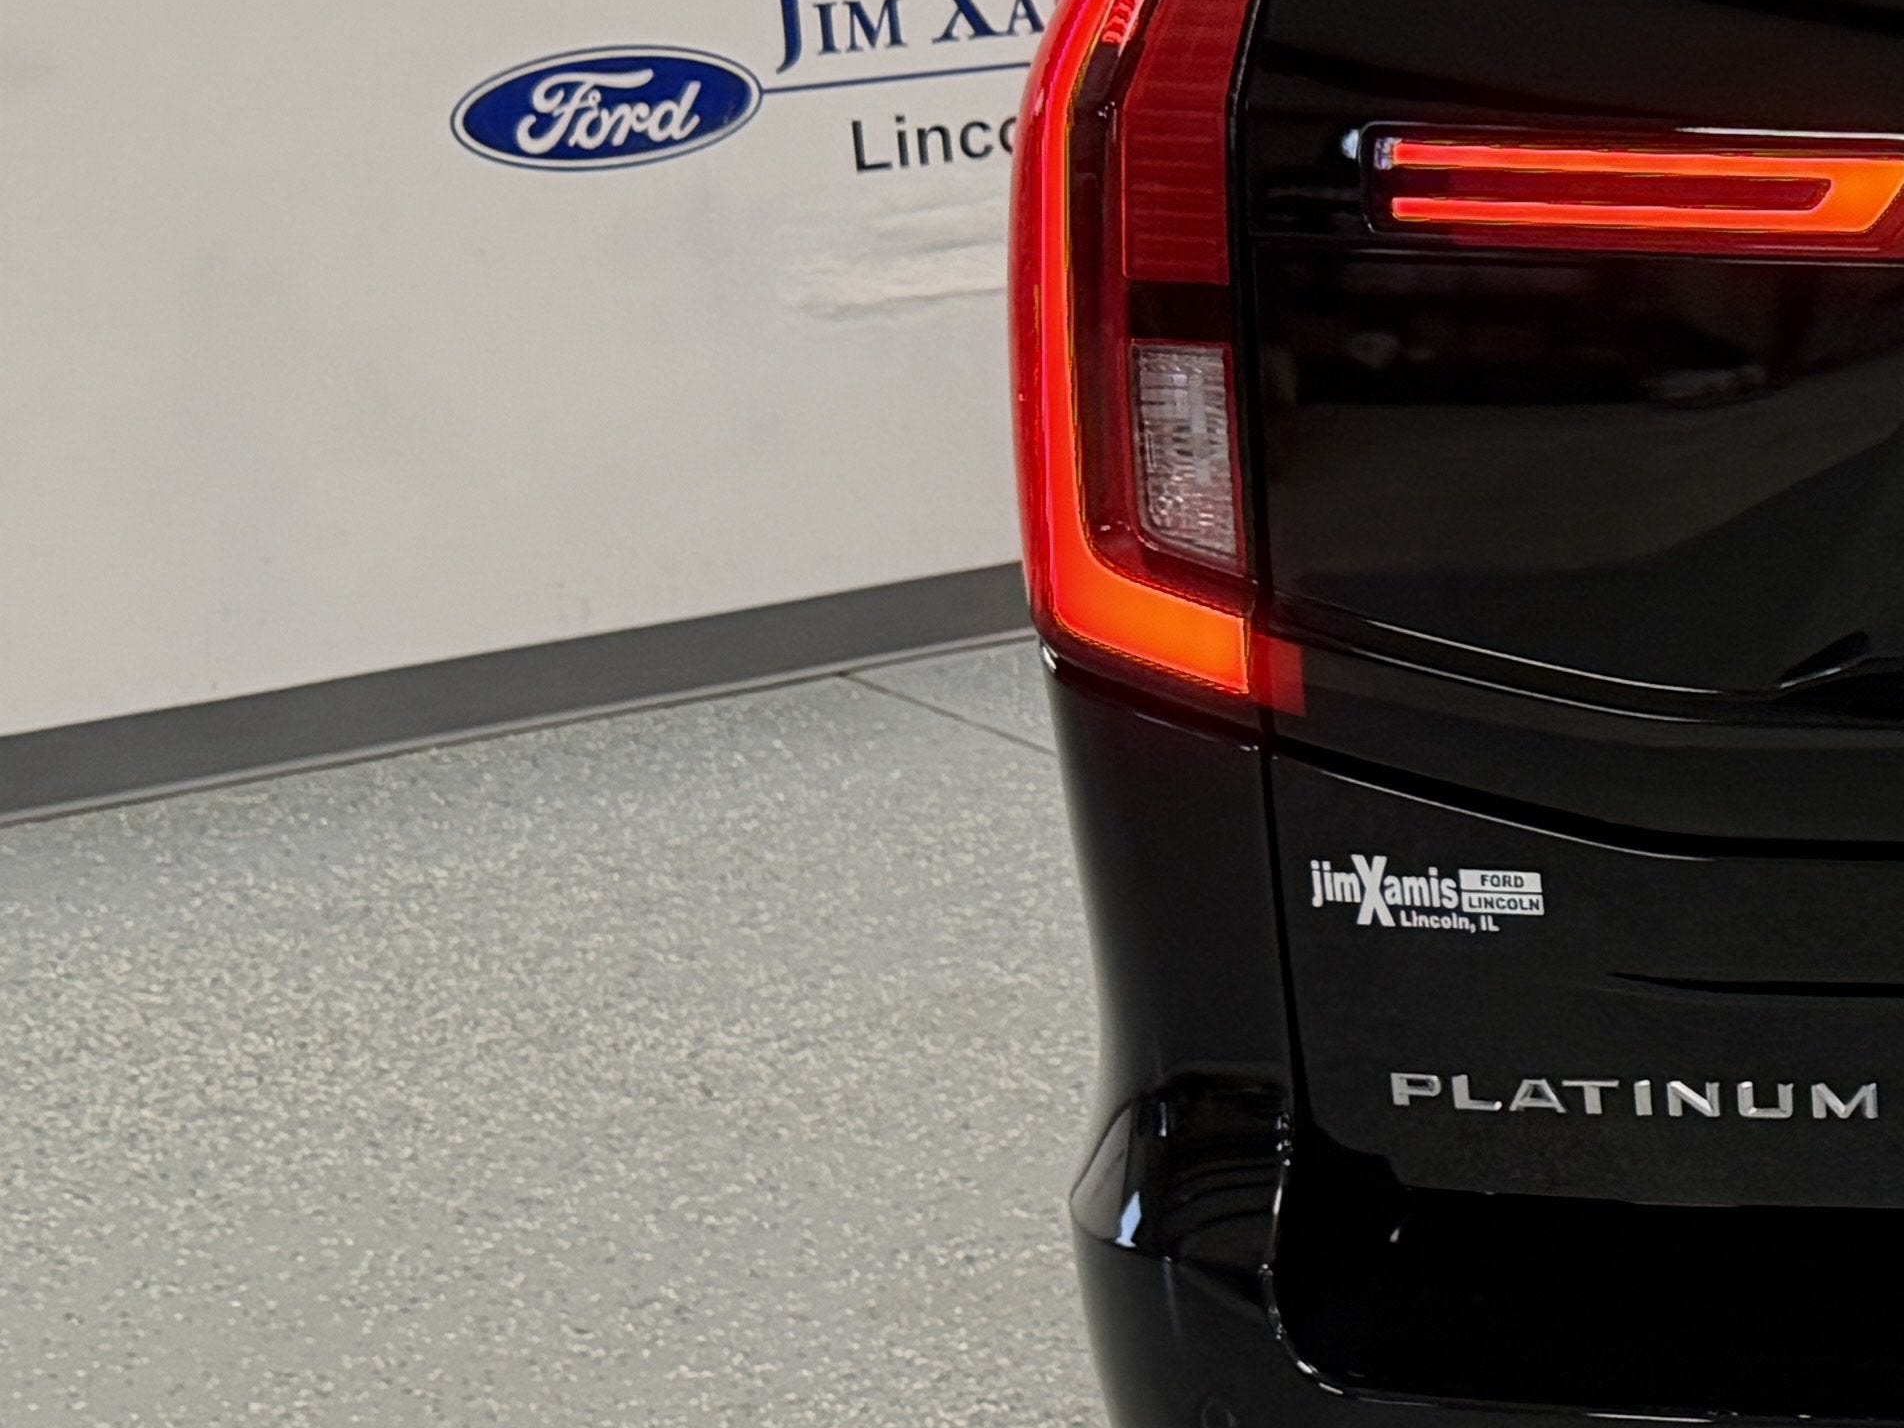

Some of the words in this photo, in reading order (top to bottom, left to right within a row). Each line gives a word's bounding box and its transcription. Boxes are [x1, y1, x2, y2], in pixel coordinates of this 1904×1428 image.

[516, 69, 702, 155] Ford
[1480, 874, 1524, 888] FORD
[1468, 896, 1540, 911] LINCOLN
[1400, 910, 1476, 933] Lincoln,
[1480, 915, 1500, 932] IL
[1390, 1072, 1878, 1119] PLATINUM
